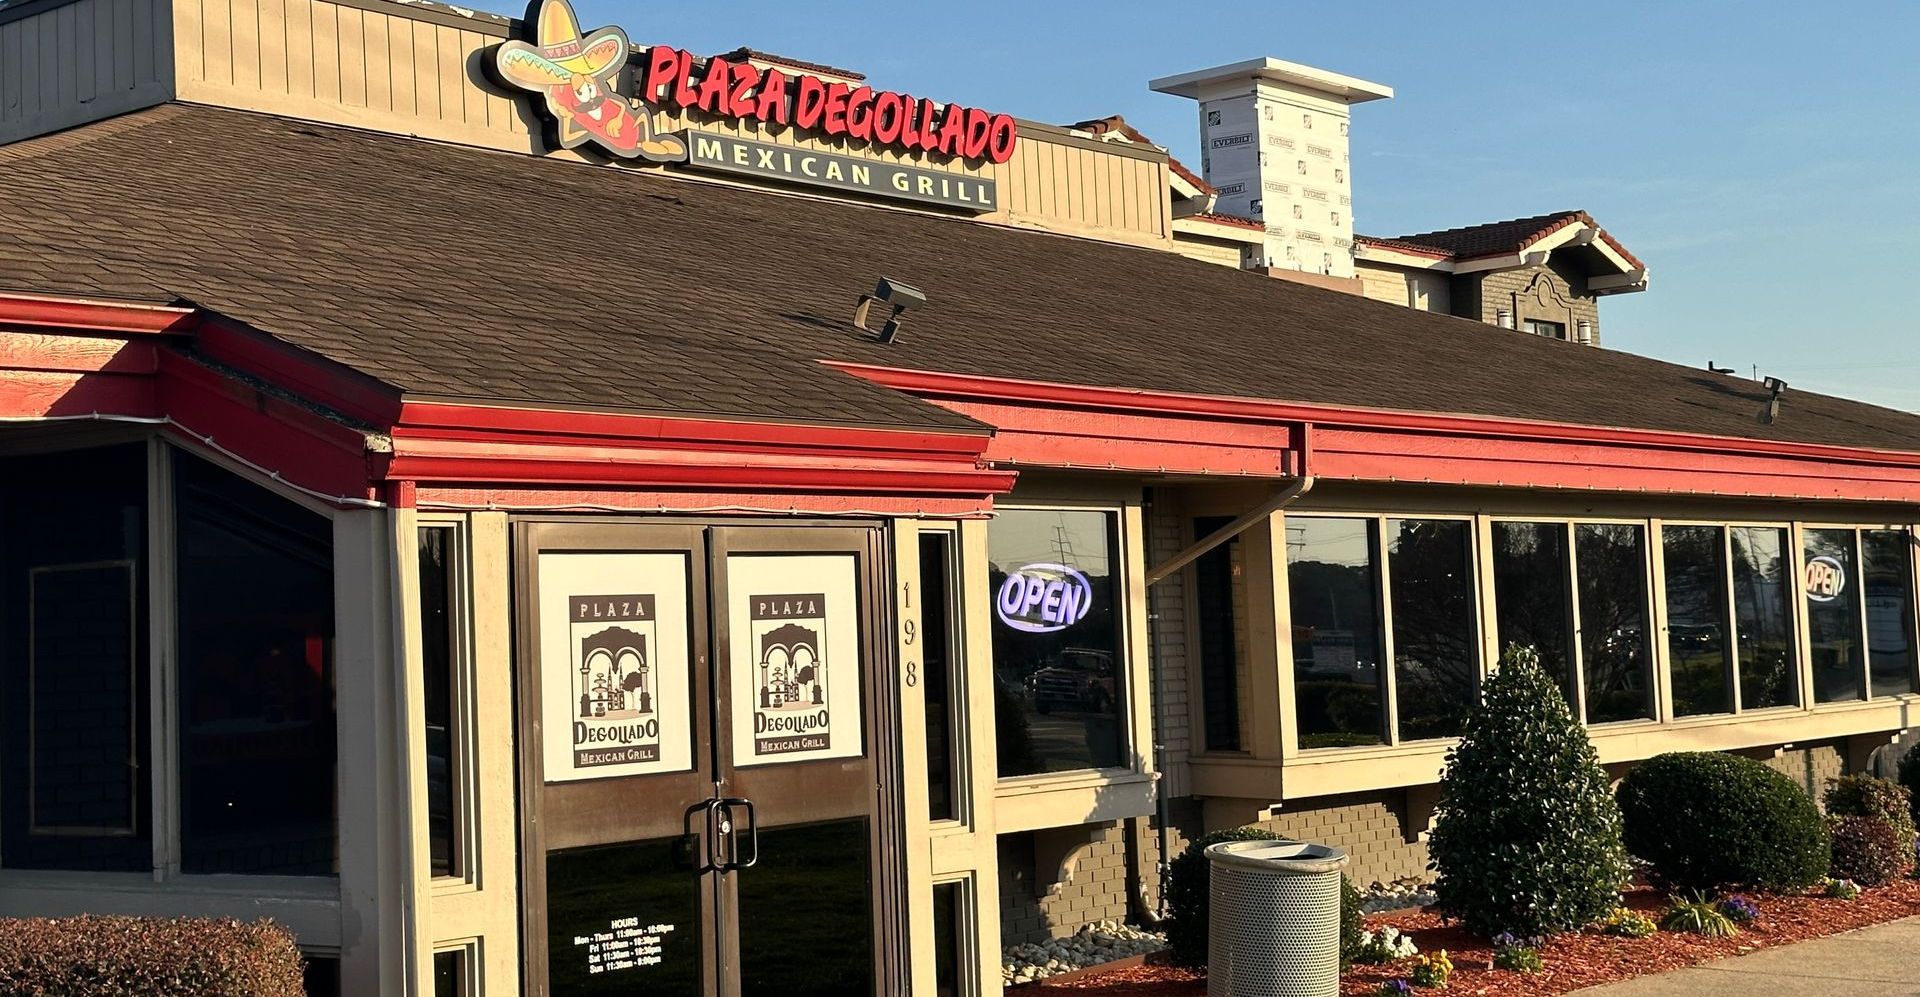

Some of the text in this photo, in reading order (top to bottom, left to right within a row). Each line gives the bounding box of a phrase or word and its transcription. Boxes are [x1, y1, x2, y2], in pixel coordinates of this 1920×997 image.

[644, 45, 1016, 164] PLAZA DEGOLLADO
[1213, 135, 1250, 148] EVERBILT
[697, 138, 992, 205] MEXICAN GRILL
[1806, 562, 1841, 596] OPEN
[1001, 573, 1083, 625] OPEN
[580, 602, 645, 618] PLAZA
[759, 600, 816, 615] PLAZA
[754, 709, 829, 734] DEGOLLADO
[574, 718, 658, 745] DEGOLLADO
[760, 737, 825, 752] MEXICAN GRILL
[580, 748, 654, 765] MEXICAN GRILL
[611, 917, 639, 929] HOURS
[574, 936, 590, 946] Mon
[593, 932, 614, 942] Thurs
[589, 943, 600, 953] Fri
[588, 954, 601, 964] Sat
[589, 964, 604, 974] Sun
